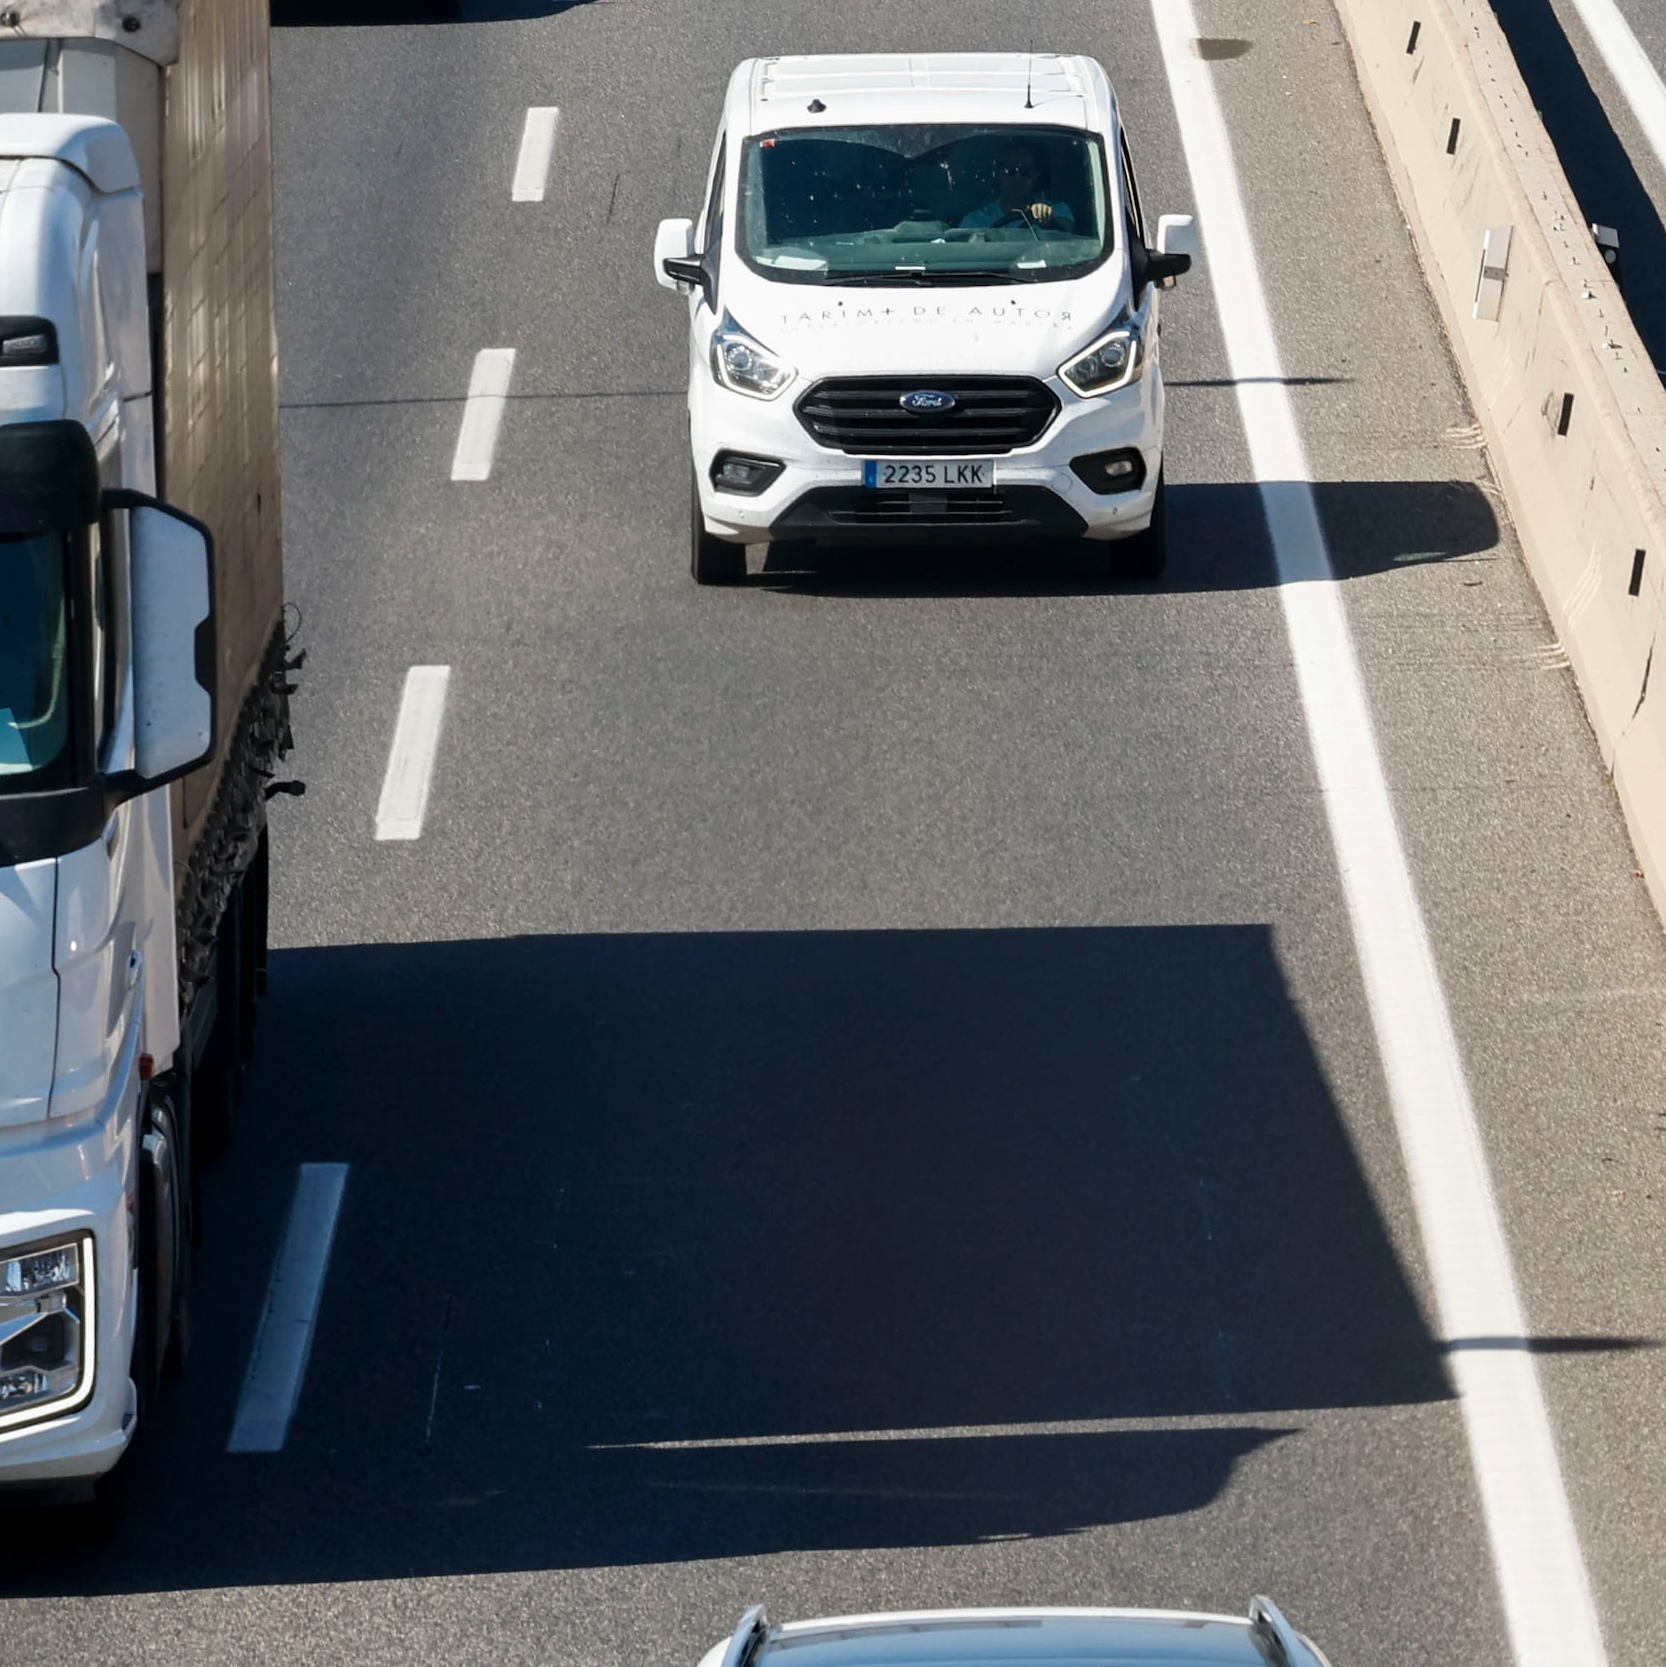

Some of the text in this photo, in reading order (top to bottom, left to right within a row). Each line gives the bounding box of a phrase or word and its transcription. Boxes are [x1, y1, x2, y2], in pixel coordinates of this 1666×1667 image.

[913, 306, 947, 316] DE
[911, 393, 944, 408] Ford
[884, 465, 983, 484] 2235 LKK
